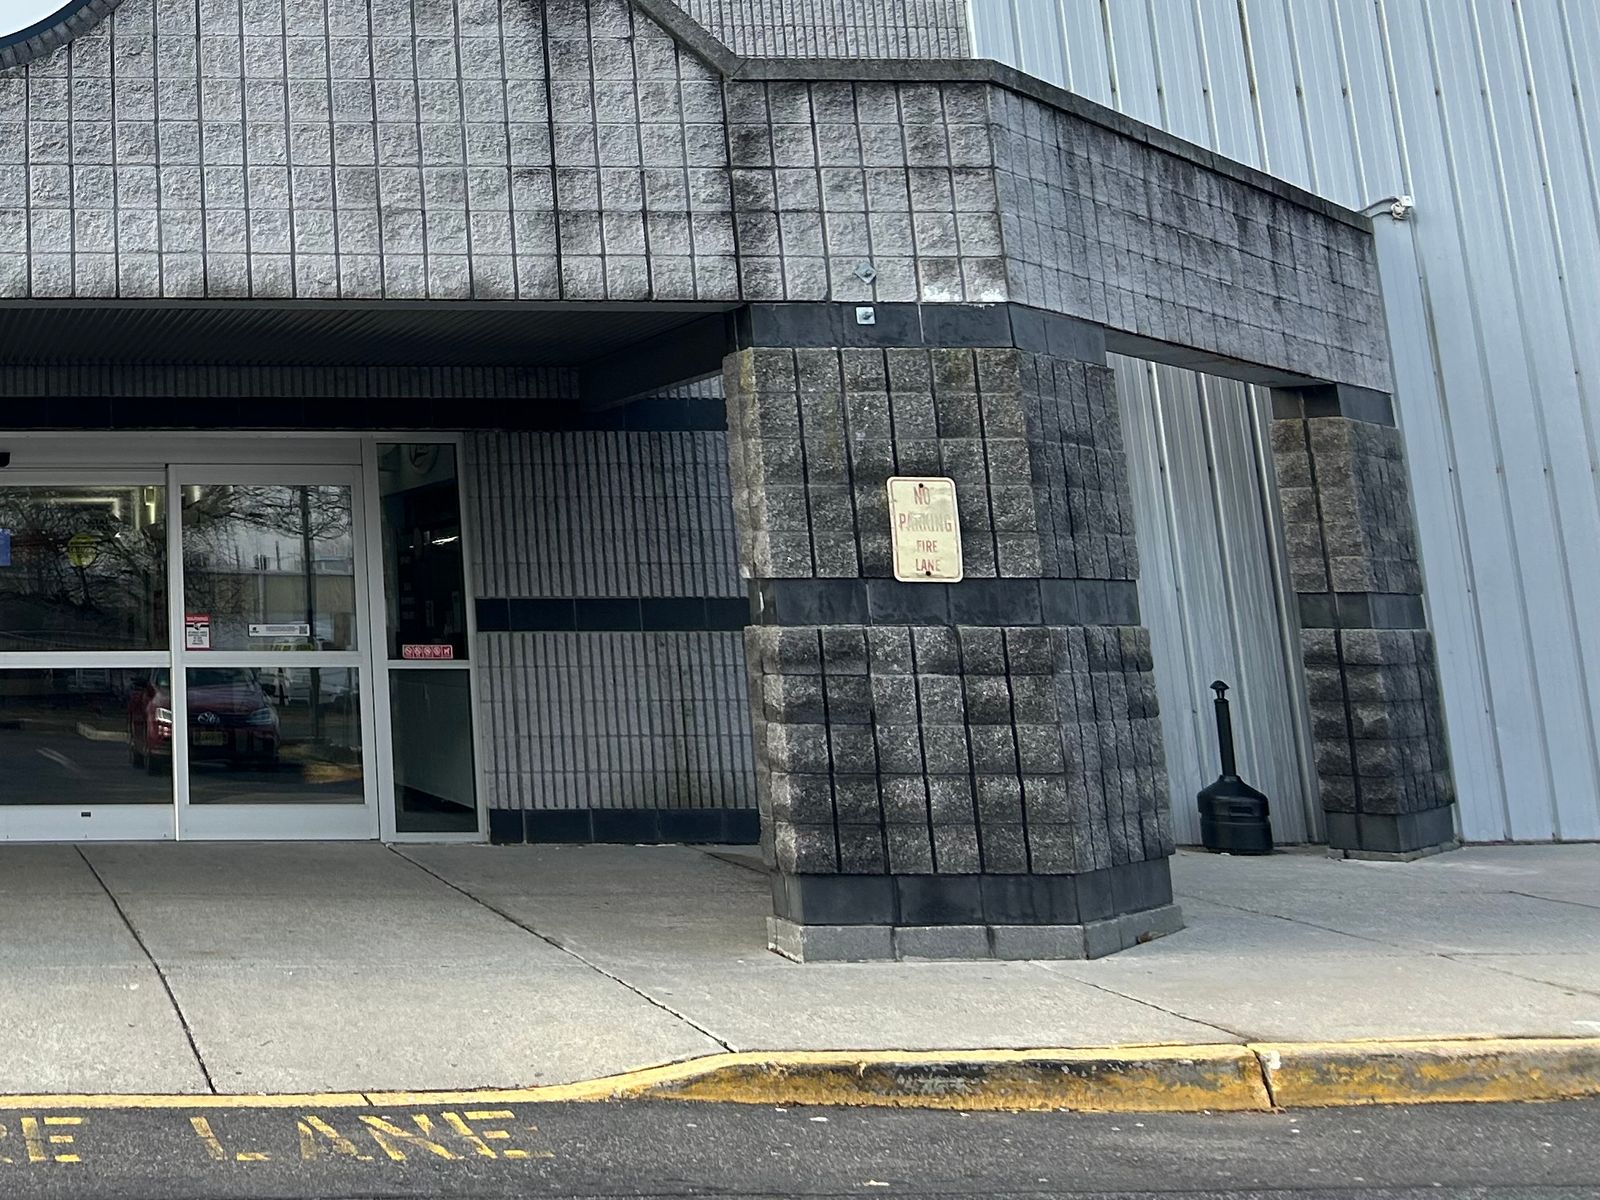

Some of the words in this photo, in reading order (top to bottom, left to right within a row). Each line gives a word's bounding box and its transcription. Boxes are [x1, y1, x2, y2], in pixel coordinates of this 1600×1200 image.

[913, 486, 931, 505] NO
[899, 513, 953, 533] PARKING
[916, 540, 938, 553] FIRE
[915, 558, 942, 572] LANE
[190, 1110, 555, 1162] LANE
